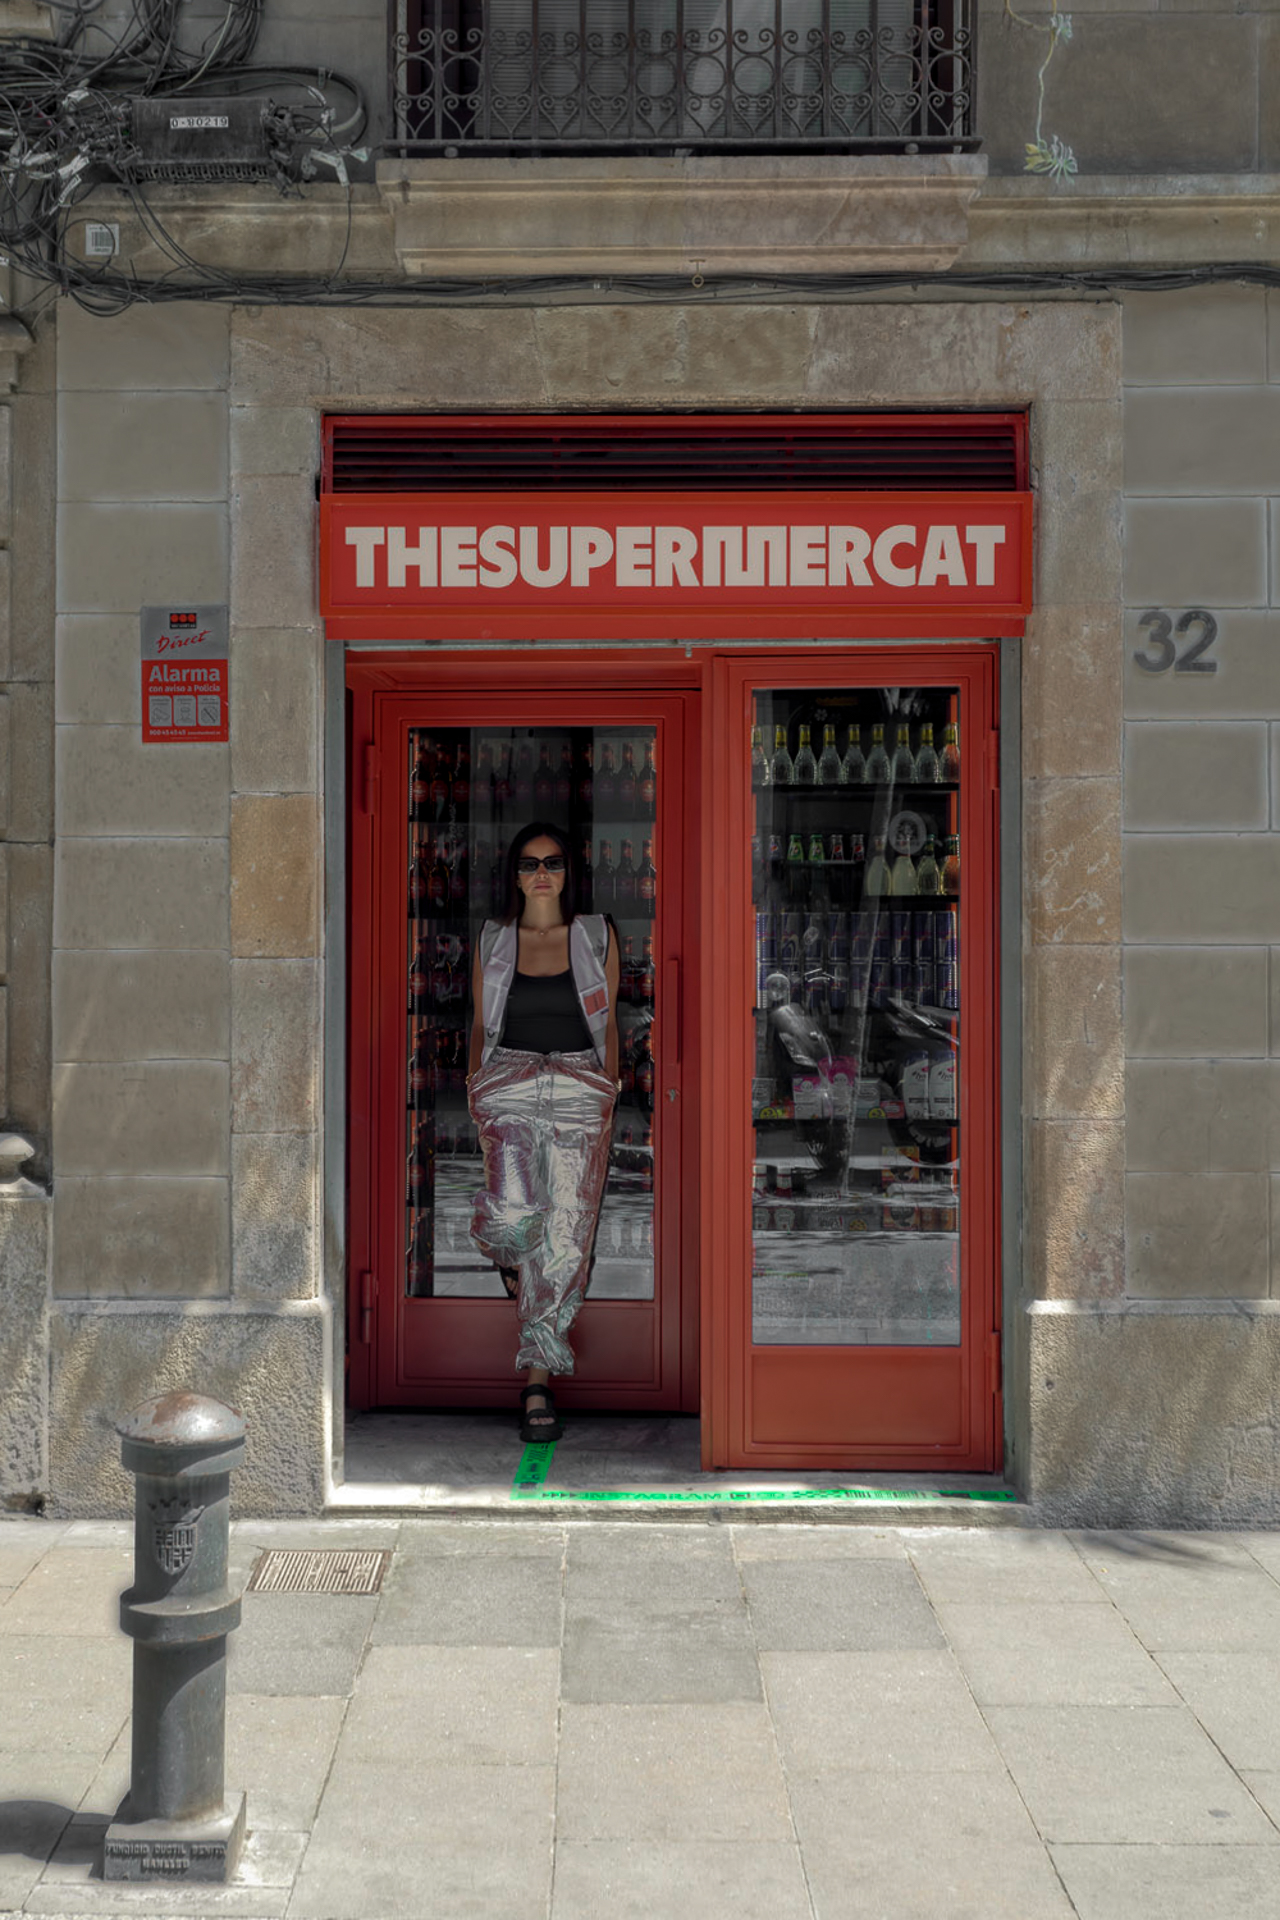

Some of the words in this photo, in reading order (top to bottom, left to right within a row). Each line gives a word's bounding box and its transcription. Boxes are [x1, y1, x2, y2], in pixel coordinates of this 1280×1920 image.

[345, 525, 1006, 589] THESUPERMERCAT
[1134, 610, 1218, 672] 32
[149, 664, 221, 682] Alarma
[164, 684, 186, 692] aviso
[582, 1491, 723, 1500] INSTAGRAM
